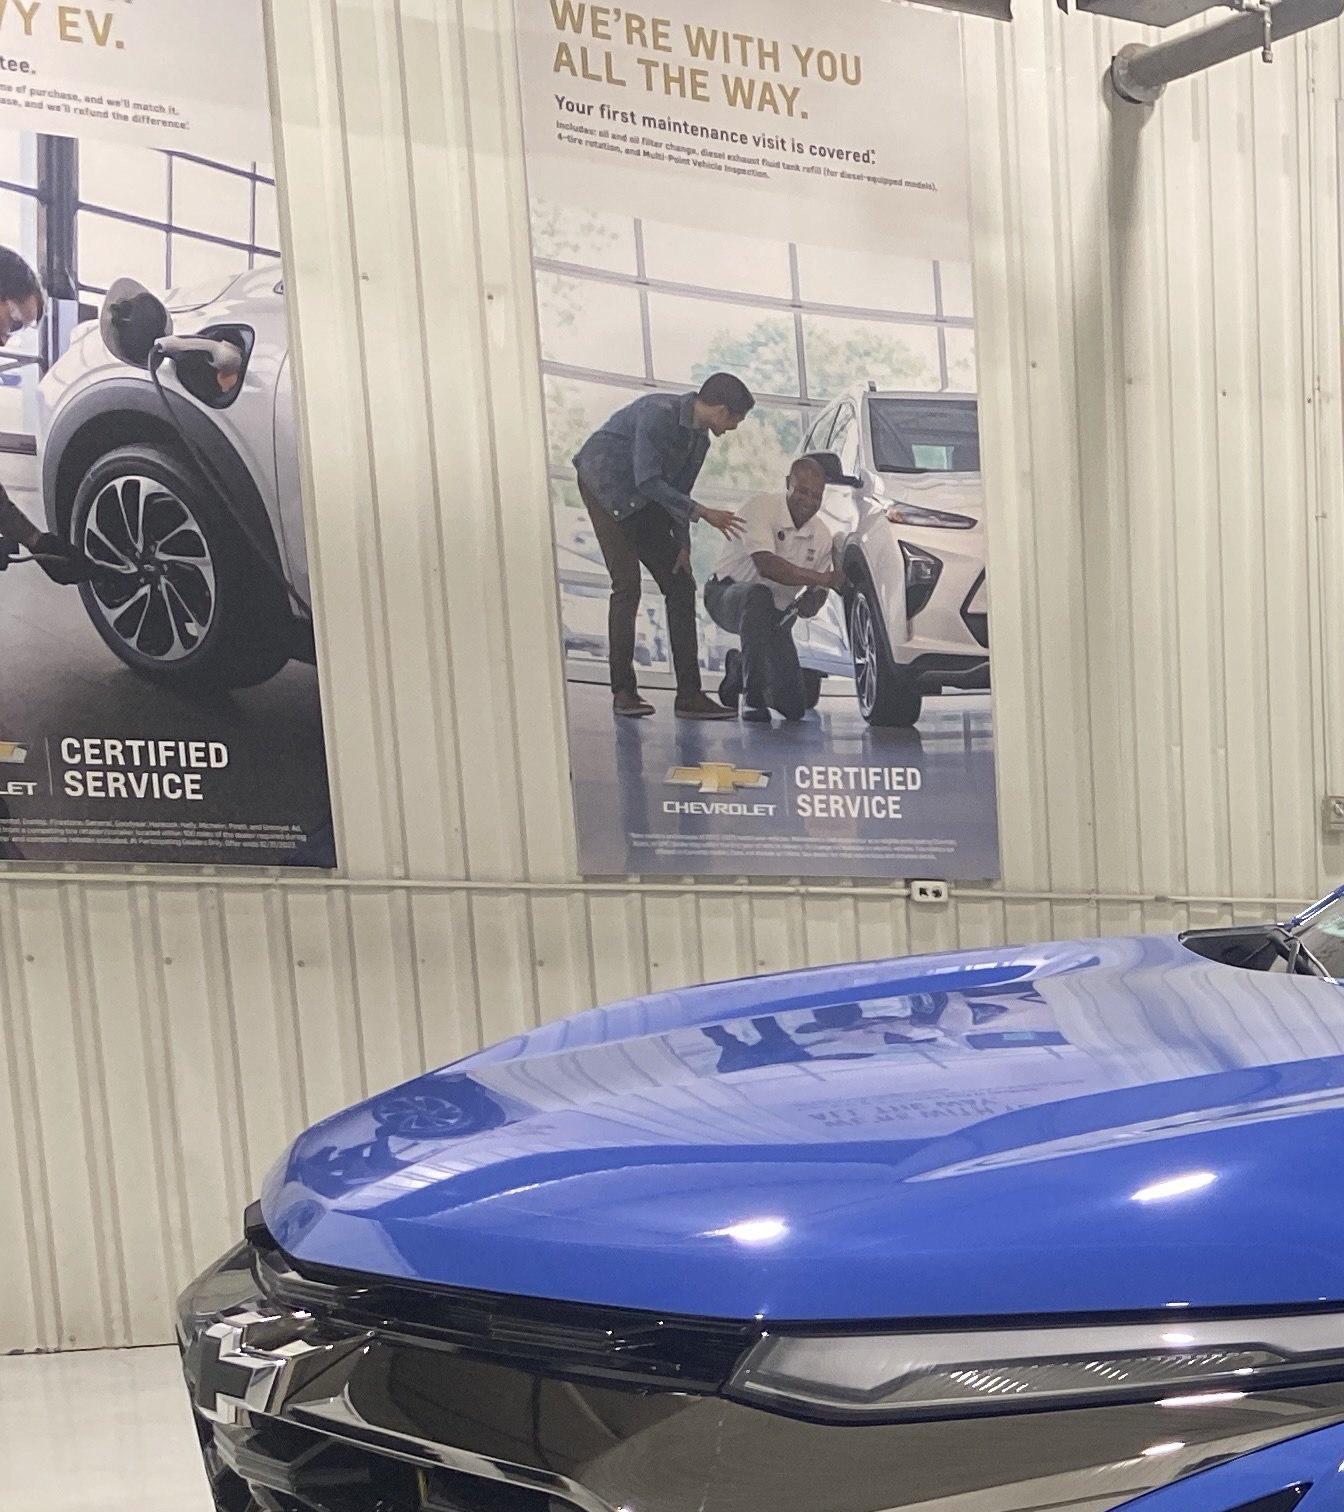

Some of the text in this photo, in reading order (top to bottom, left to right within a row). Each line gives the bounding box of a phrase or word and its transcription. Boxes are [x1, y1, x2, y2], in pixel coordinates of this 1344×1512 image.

[0, 0, 125, 49] Y EV.
[549, 0, 862, 86] WE'RE WITH YOU
[553, 42, 809, 120] ALL THE WAY.
[555, 94, 594, 117] Your
[600, 104, 637, 127] first
[642, 115, 748, 145] maintenance
[752, 133, 787, 152] visit
[791, 138, 805, 153] is
[60, 737, 229, 769] CERTIFIED
[63, 770, 204, 800] SERVICE
[795, 765, 922, 791] CERTIFIED
[663, 801, 776, 816] CHEVROLET
[797, 794, 903, 819] SERVICE
